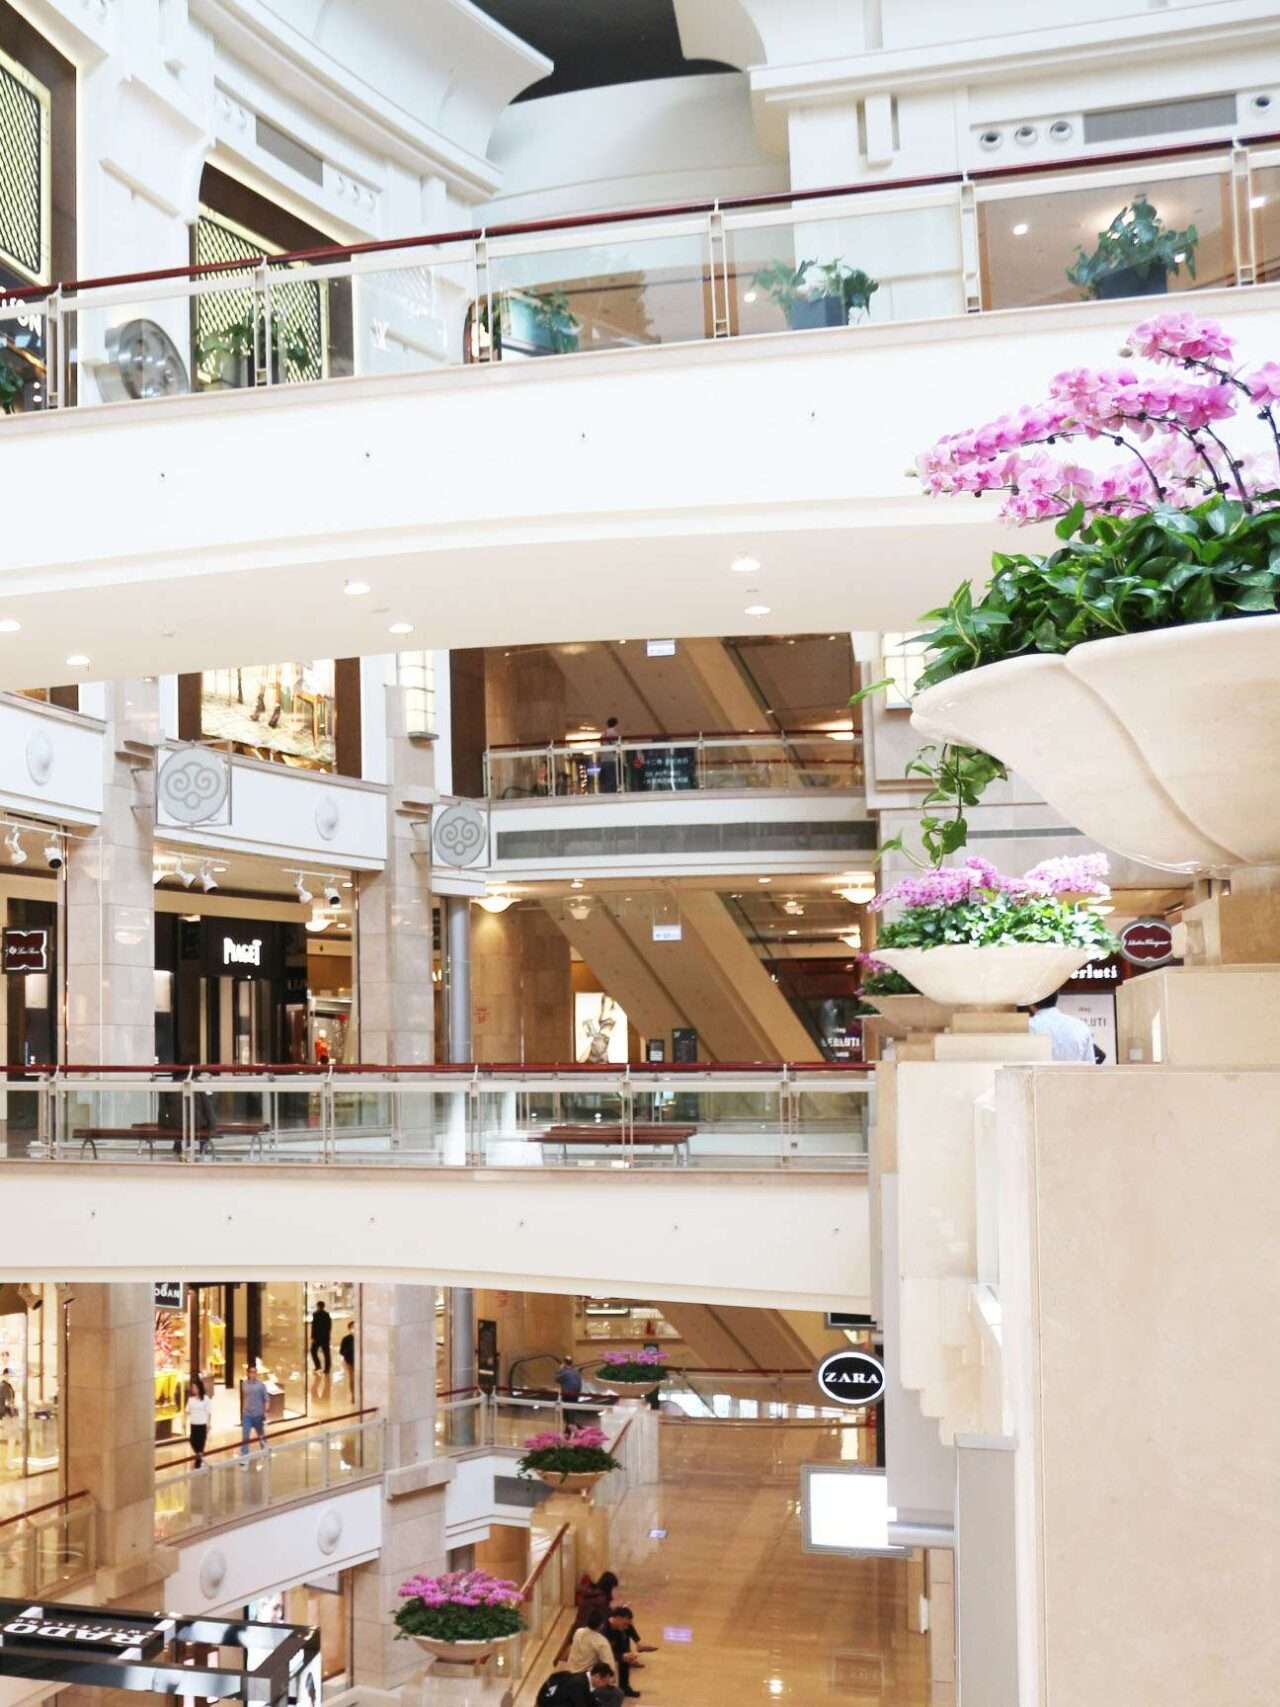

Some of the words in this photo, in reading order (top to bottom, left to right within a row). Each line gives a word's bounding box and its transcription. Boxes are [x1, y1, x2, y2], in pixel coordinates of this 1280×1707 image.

[223, 937, 263, 966] PIAGET
[1071, 963, 1118, 979] erluti
[153, 1282, 181, 1297] OGAN
[824, 1371, 880, 1384] ZARA
[3, 1622, 149, 1645] RADO
